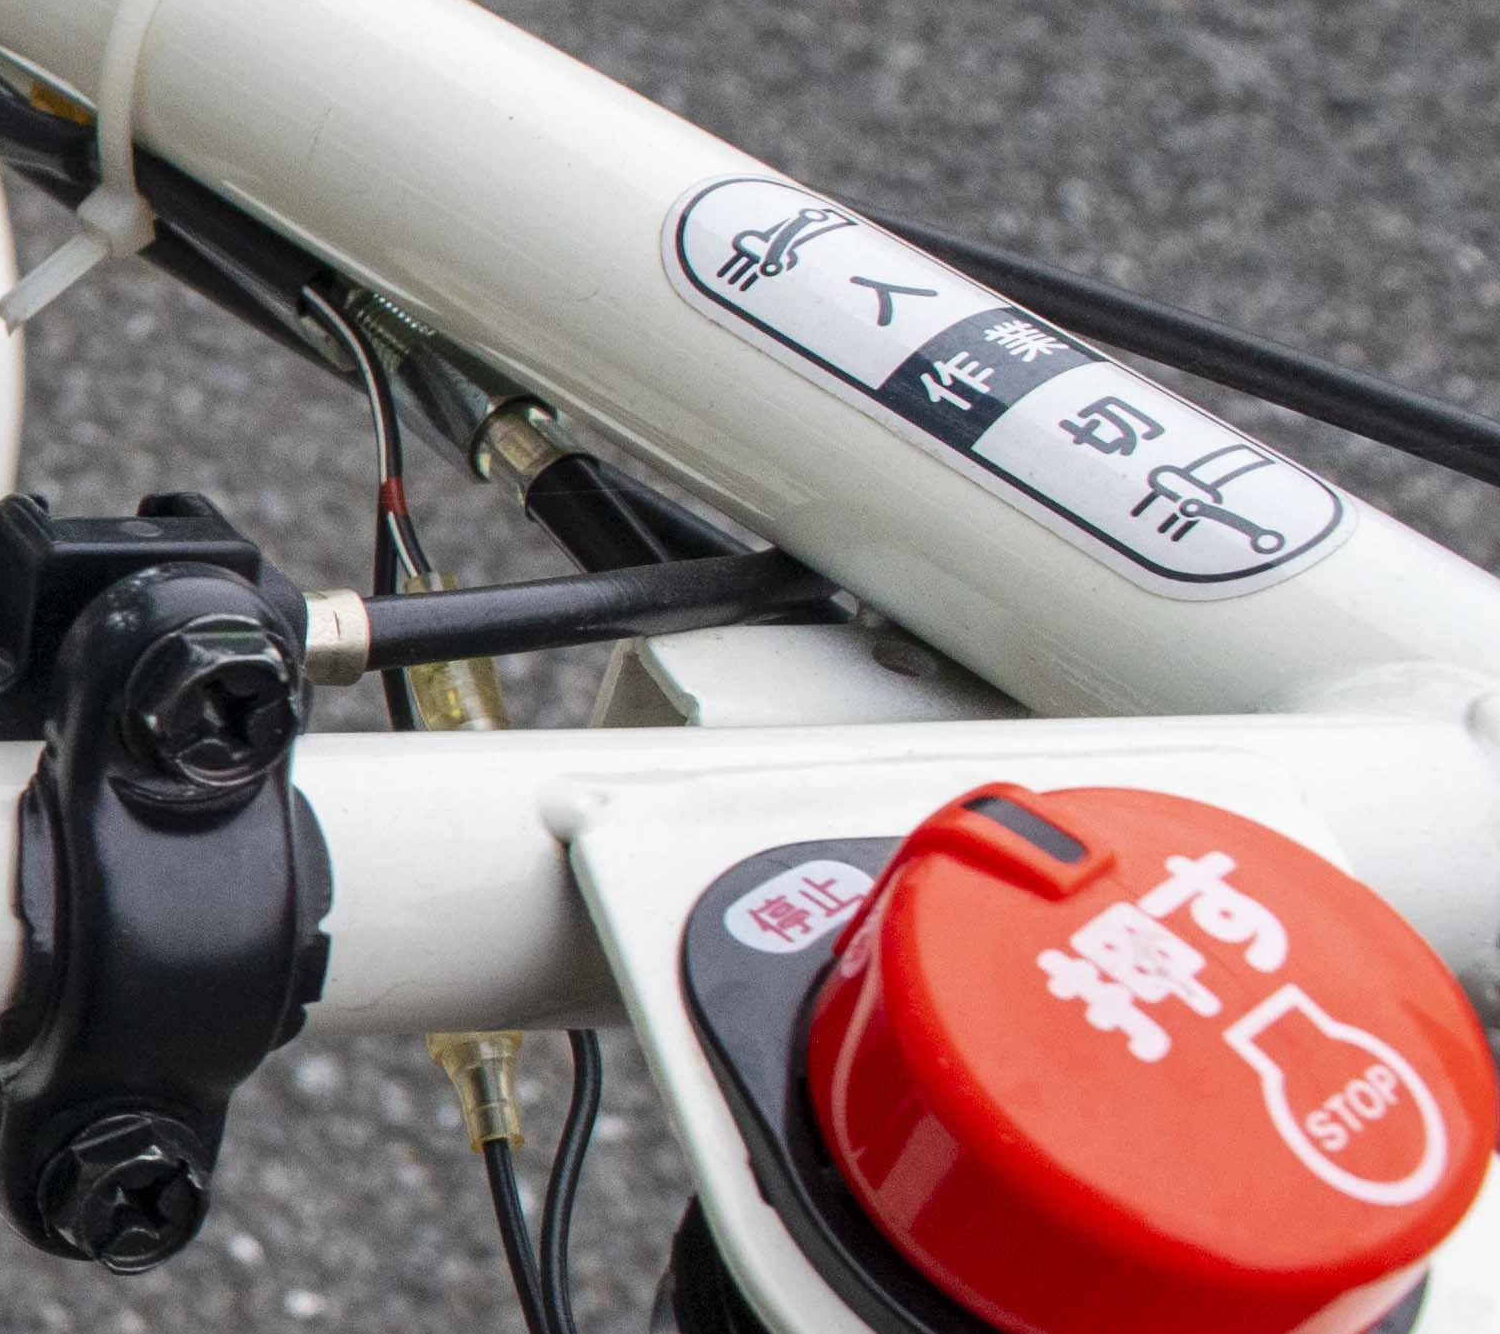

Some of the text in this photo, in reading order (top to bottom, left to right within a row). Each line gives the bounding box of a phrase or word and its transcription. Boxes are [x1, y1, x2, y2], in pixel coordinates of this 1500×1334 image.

[919, 319, 1072, 412] 作業
[1057, 395, 1167, 457] 切
[747, 874, 868, 945] 停止
[1036, 850, 1290, 1064] 押す
[1305, 1063, 1402, 1154] STOP
